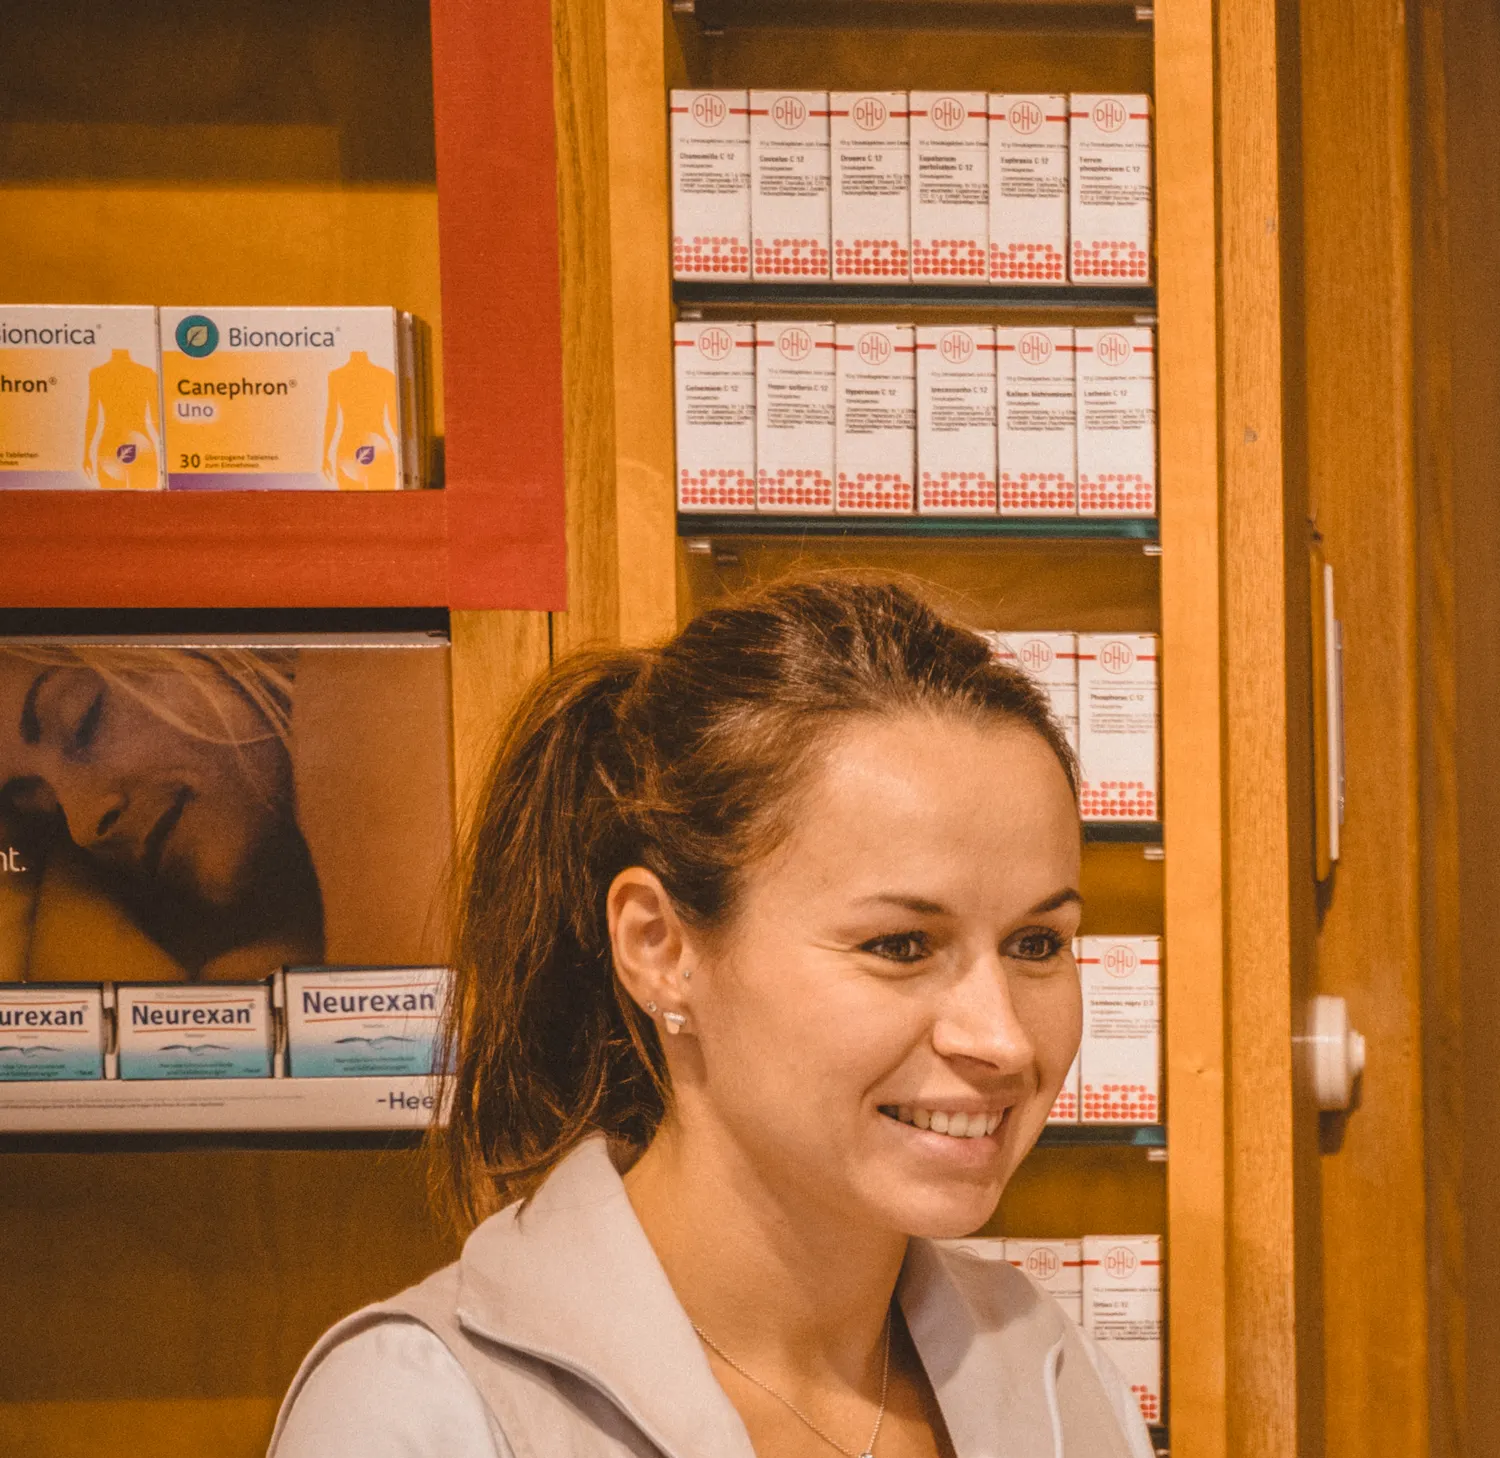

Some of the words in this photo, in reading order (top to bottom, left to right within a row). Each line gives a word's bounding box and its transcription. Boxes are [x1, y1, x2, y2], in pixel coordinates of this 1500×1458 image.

[695, 98, 723, 125] DHU
[775, 100, 803, 126] DHU
[856, 101, 884, 127] DHU
[934, 100, 962, 127] DHU
[1012, 103, 1040, 131] DHU
[1096, 101, 1124, 129] DHU
[0, 323, 96, 345] ionorica
[229, 326, 335, 348] Bionorica
[701, 332, 728, 357] DHU
[781, 332, 808, 357] DHU
[943, 334, 970, 360] DHU
[861, 336, 888, 361] DHU
[1022, 335, 1050, 361] DHU
[1100, 336, 1127, 362] DHU
[177, 403, 214, 418] Uno
[180, 453, 200, 468] 30
